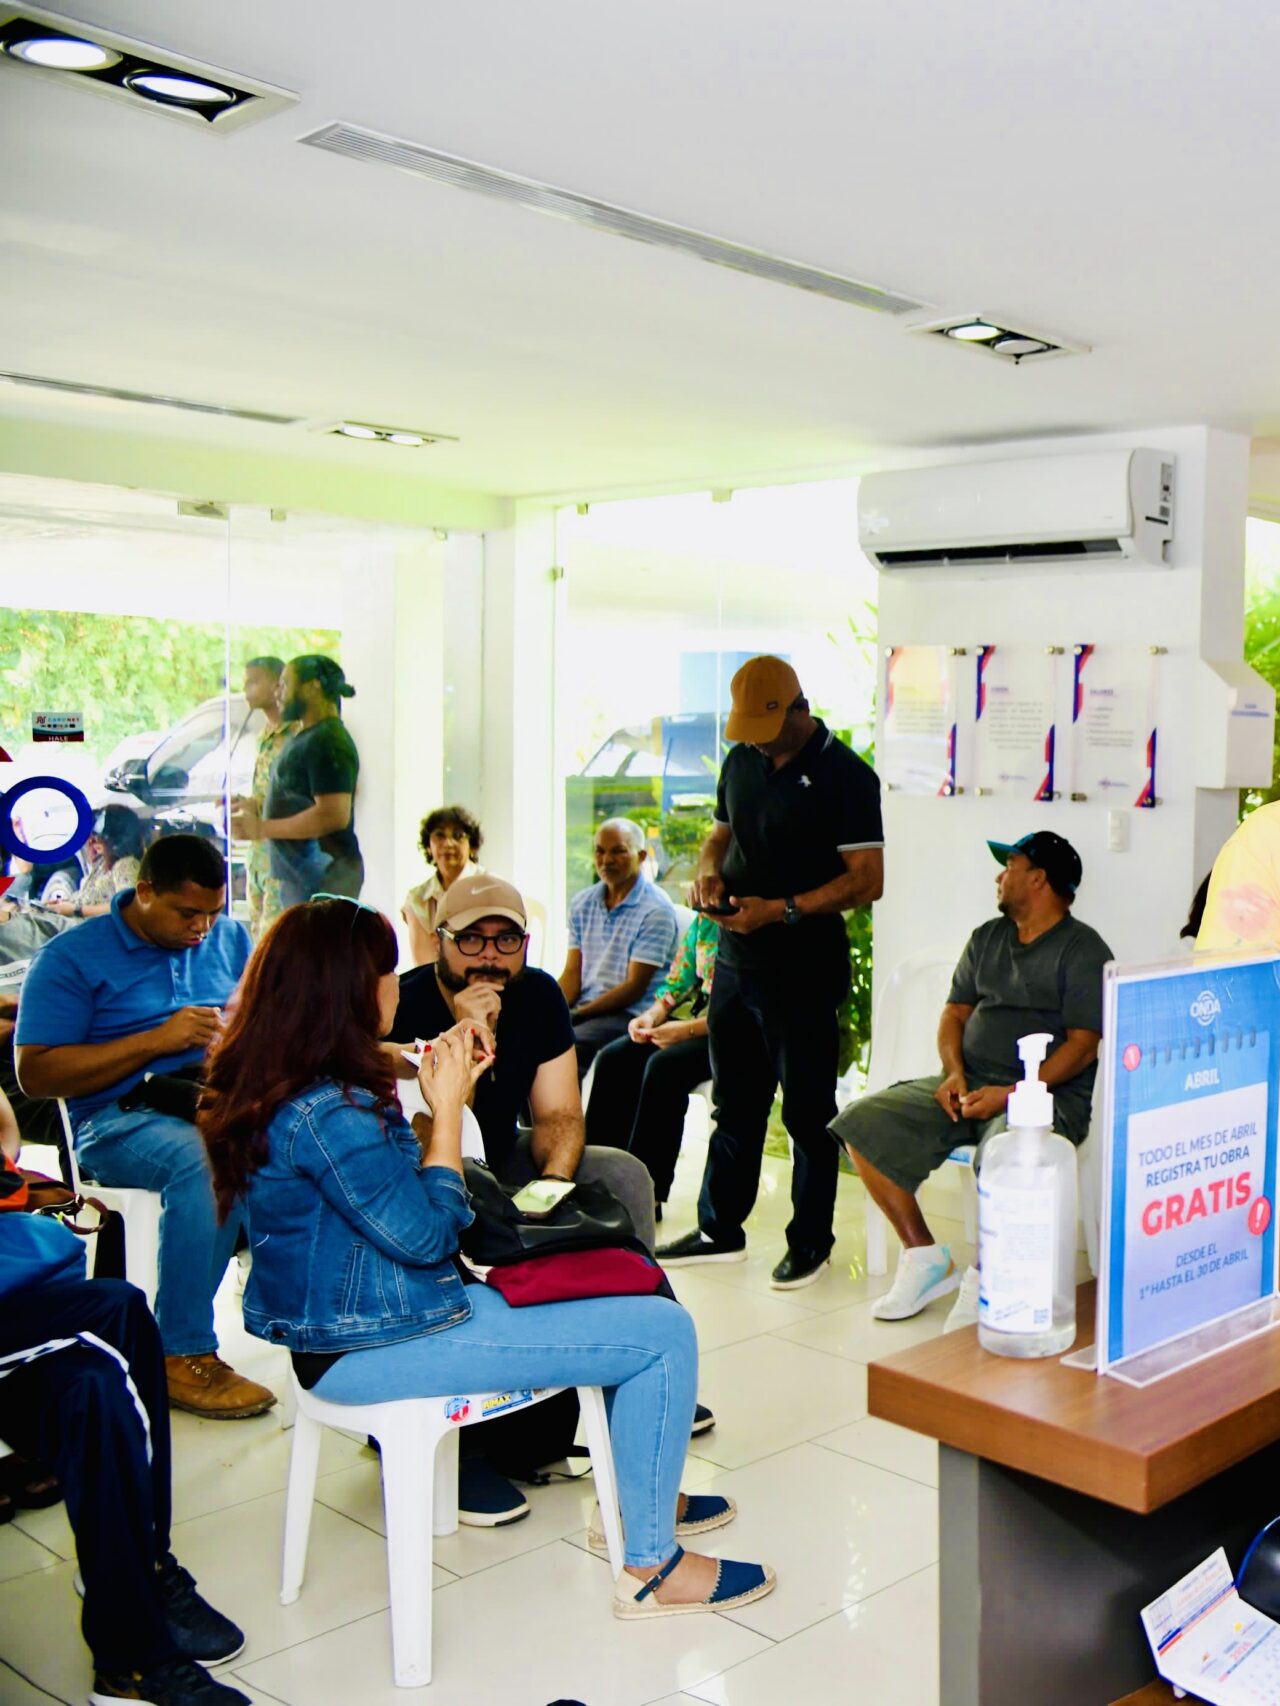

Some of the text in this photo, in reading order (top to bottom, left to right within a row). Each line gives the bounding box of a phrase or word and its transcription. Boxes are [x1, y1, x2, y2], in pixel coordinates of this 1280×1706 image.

[1184, 1068, 1220, 1091] ABRIL
[1139, 1122, 1257, 1167] TODO EL MES DE ABRIL
[1146, 1145, 1250, 1188] REGISTRA TU OBRA
[1142, 1171, 1251, 1236] GRATIS
[1151, 1273, 1183, 1295] HASTA
[1184, 1269, 1195, 1284] EL
[1197, 1263, 1208, 1278] 30
[1210, 1257, 1221, 1273] DE
[1222, 1248, 1249, 1268] ABRIL
[1175, 1242, 1218, 1268] DESDE EL
